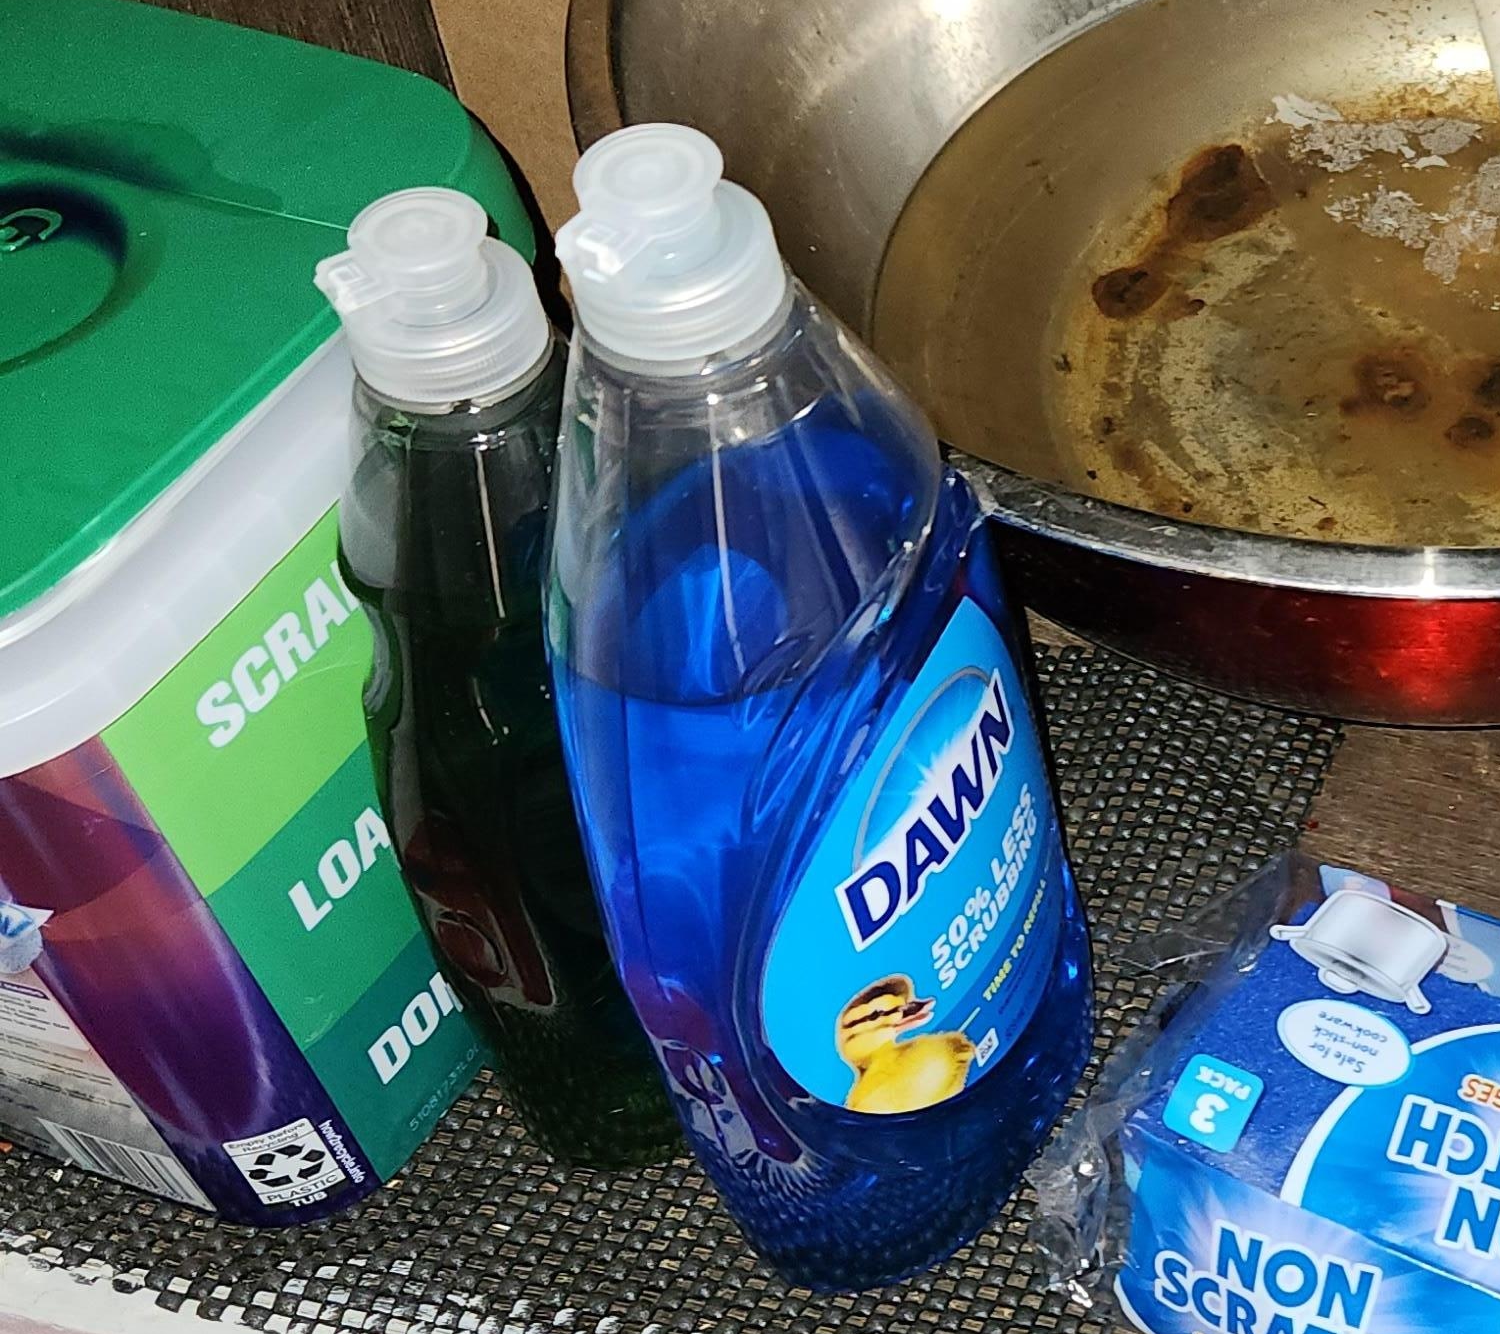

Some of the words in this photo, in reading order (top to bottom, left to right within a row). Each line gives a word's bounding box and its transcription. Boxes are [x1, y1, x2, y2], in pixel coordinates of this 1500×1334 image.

[842, 675, 1012, 945] DAWN
[287, 806, 401, 933] LOA
[931, 886, 991, 970] 50%
[990, 782, 1031, 886] LESS
[938, 808, 1037, 991] SCRUBBING
[983, 956, 1012, 1002] TIME
[1010, 933, 1025, 958] TO
[1312, 1024, 1379, 1058] non-stick
[1317, 1010, 1389, 1045] cookware
[1308, 1041, 1331, 1060] for
[1334, 1050, 1368, 1074] Safe
[1194, 1065, 1253, 1101] PACK
[1189, 1092, 1229, 1134] 3
[228, 1137, 265, 1150] Empty
[267, 1122, 306, 1141] Before
[242, 1132, 300, 1153] Recycling
[266, 1174, 339, 1203] PLASTIC
[288, 1190, 328, 1207] TUB
[1217, 1226, 1375, 1329] NON
